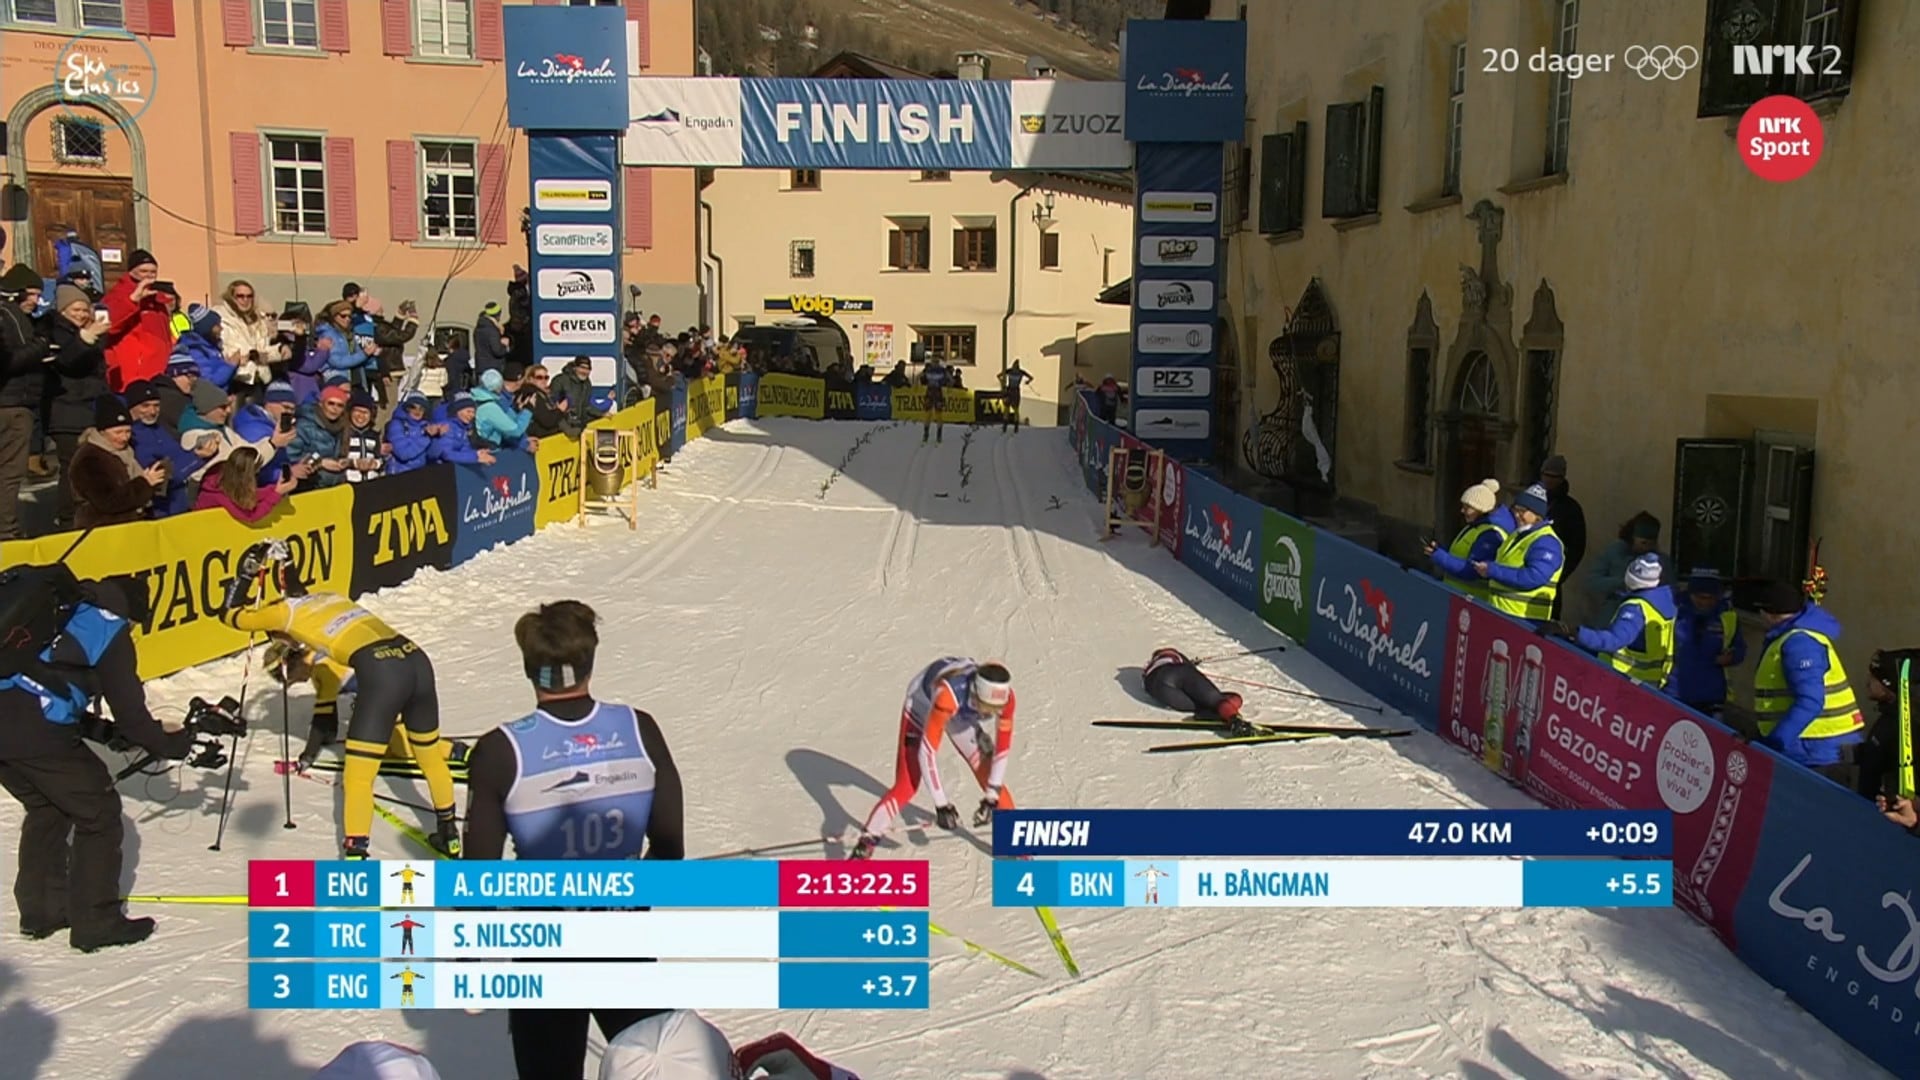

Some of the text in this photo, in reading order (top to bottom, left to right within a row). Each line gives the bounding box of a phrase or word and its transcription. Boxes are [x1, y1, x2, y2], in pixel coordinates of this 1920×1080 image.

[517, 58, 616, 84] La Diagonela
[1137, 71, 1233, 97] La Diagonela
[685, 115, 734, 131] Engadin
[776, 103, 974, 144] FINISH
[1052, 114, 1122, 134] ZUOZ
[543, 233, 596, 246] ScandFibre
[790, 294, 836, 317] Volg
[549, 319, 607, 336] CAVEGN
[464, 495, 480, 523] La
[481, 472, 532, 522] Diagonela
[367, 496, 449, 567] TWA
[1185, 504, 1200, 539] La
[1201, 509, 1254, 573] Diagonela
[1316, 576, 1431, 678] La Diagonela
[1552, 674, 1607, 728] Bock
[1609, 714, 1656, 753] auf
[1546, 713, 1642, 791] Gazosa?
[1663, 740, 1712, 776] Probier's
[594, 771, 637, 785] Engadin
[1660, 758, 1686, 779] jetzt
[1666, 778, 1692, 801] viva!
[560, 808, 625, 858] 103
[1768, 853, 1846, 942] La
